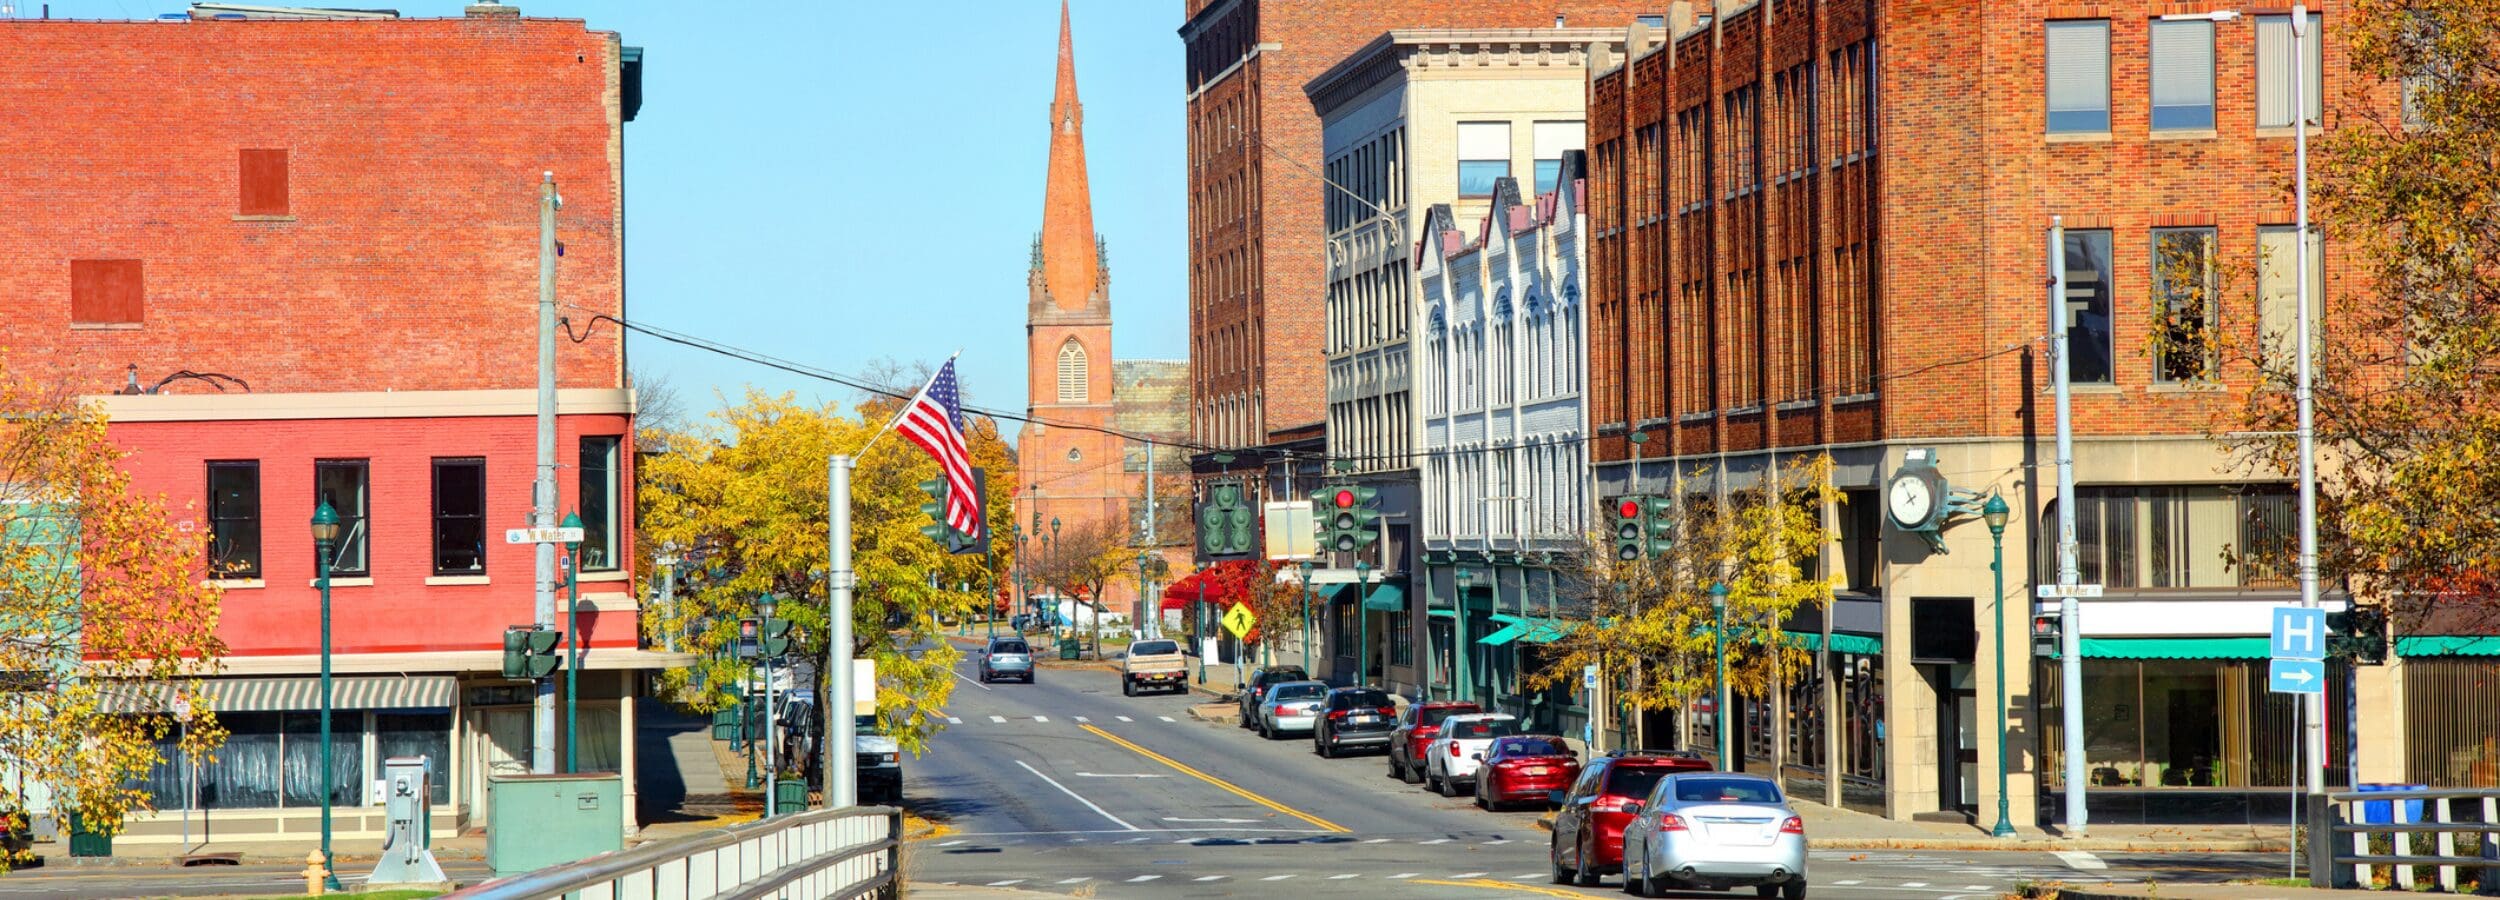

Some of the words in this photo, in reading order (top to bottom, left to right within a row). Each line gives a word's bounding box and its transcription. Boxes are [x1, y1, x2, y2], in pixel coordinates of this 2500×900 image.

[529, 530, 536, 541] W
[540, 529, 566, 541] Water
[2282, 614, 2314, 652] H
